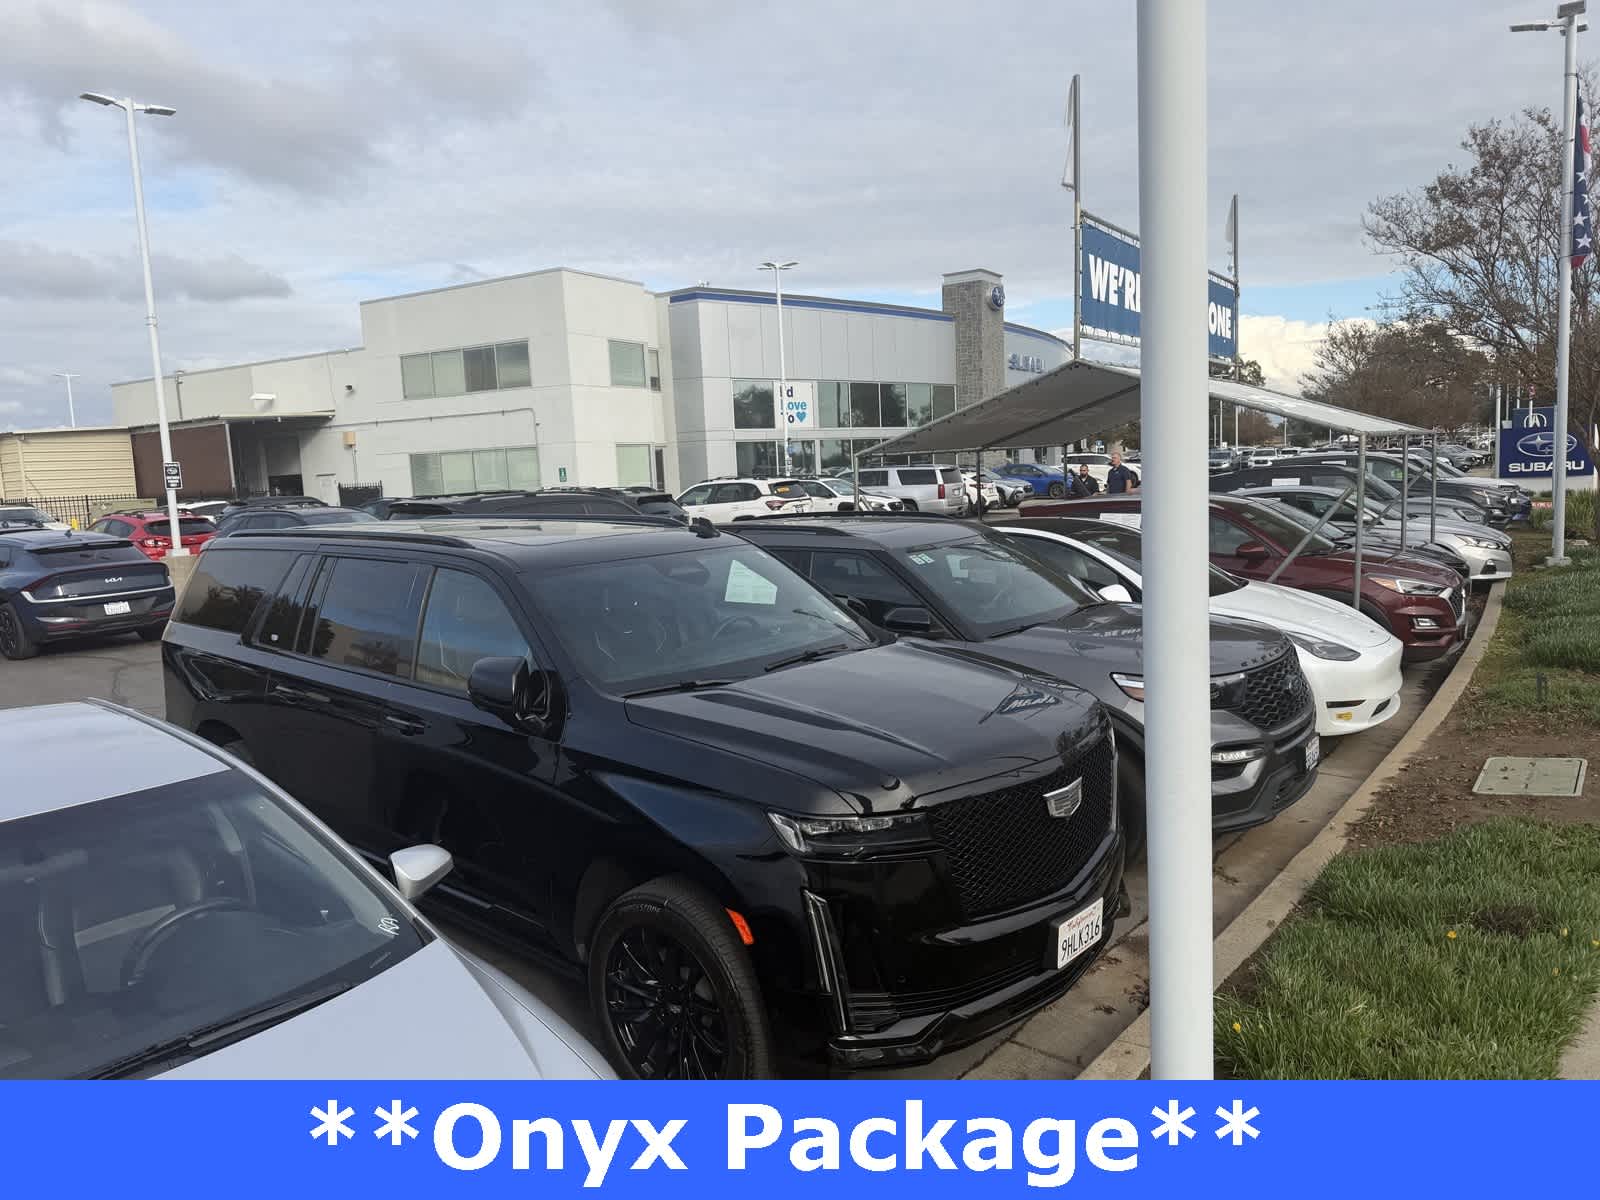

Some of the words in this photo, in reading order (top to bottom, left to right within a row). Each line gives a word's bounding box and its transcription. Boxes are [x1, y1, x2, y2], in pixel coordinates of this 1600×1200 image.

[780, 385, 794, 398] Id
[780, 411, 795, 424] o
[1061, 914, 1101, 962] 9HLK316
